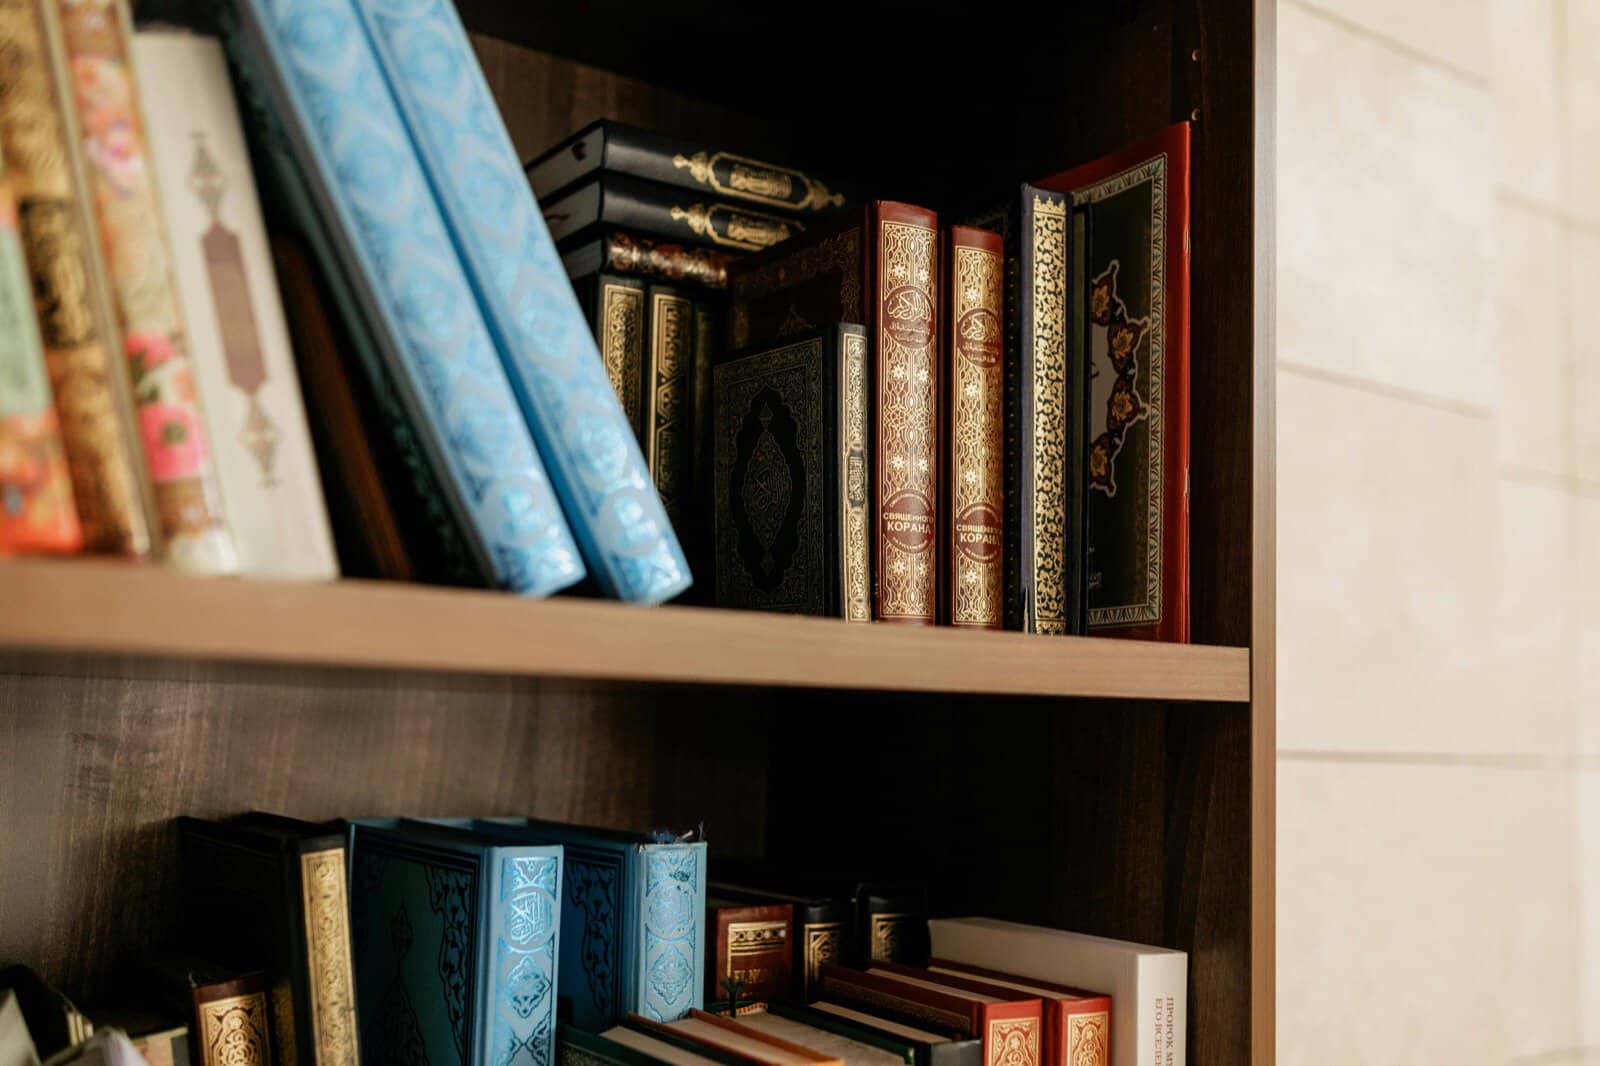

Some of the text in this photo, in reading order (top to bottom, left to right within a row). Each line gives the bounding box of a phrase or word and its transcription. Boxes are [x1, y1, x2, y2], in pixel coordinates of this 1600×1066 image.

[887, 521, 931, 534] КОРАНА
[960, 533, 1000, 545] КОРАНА
[1155, 998, 1163, 1021] ЕГО
[1166, 997, 1174, 1048] ПРОРОК
